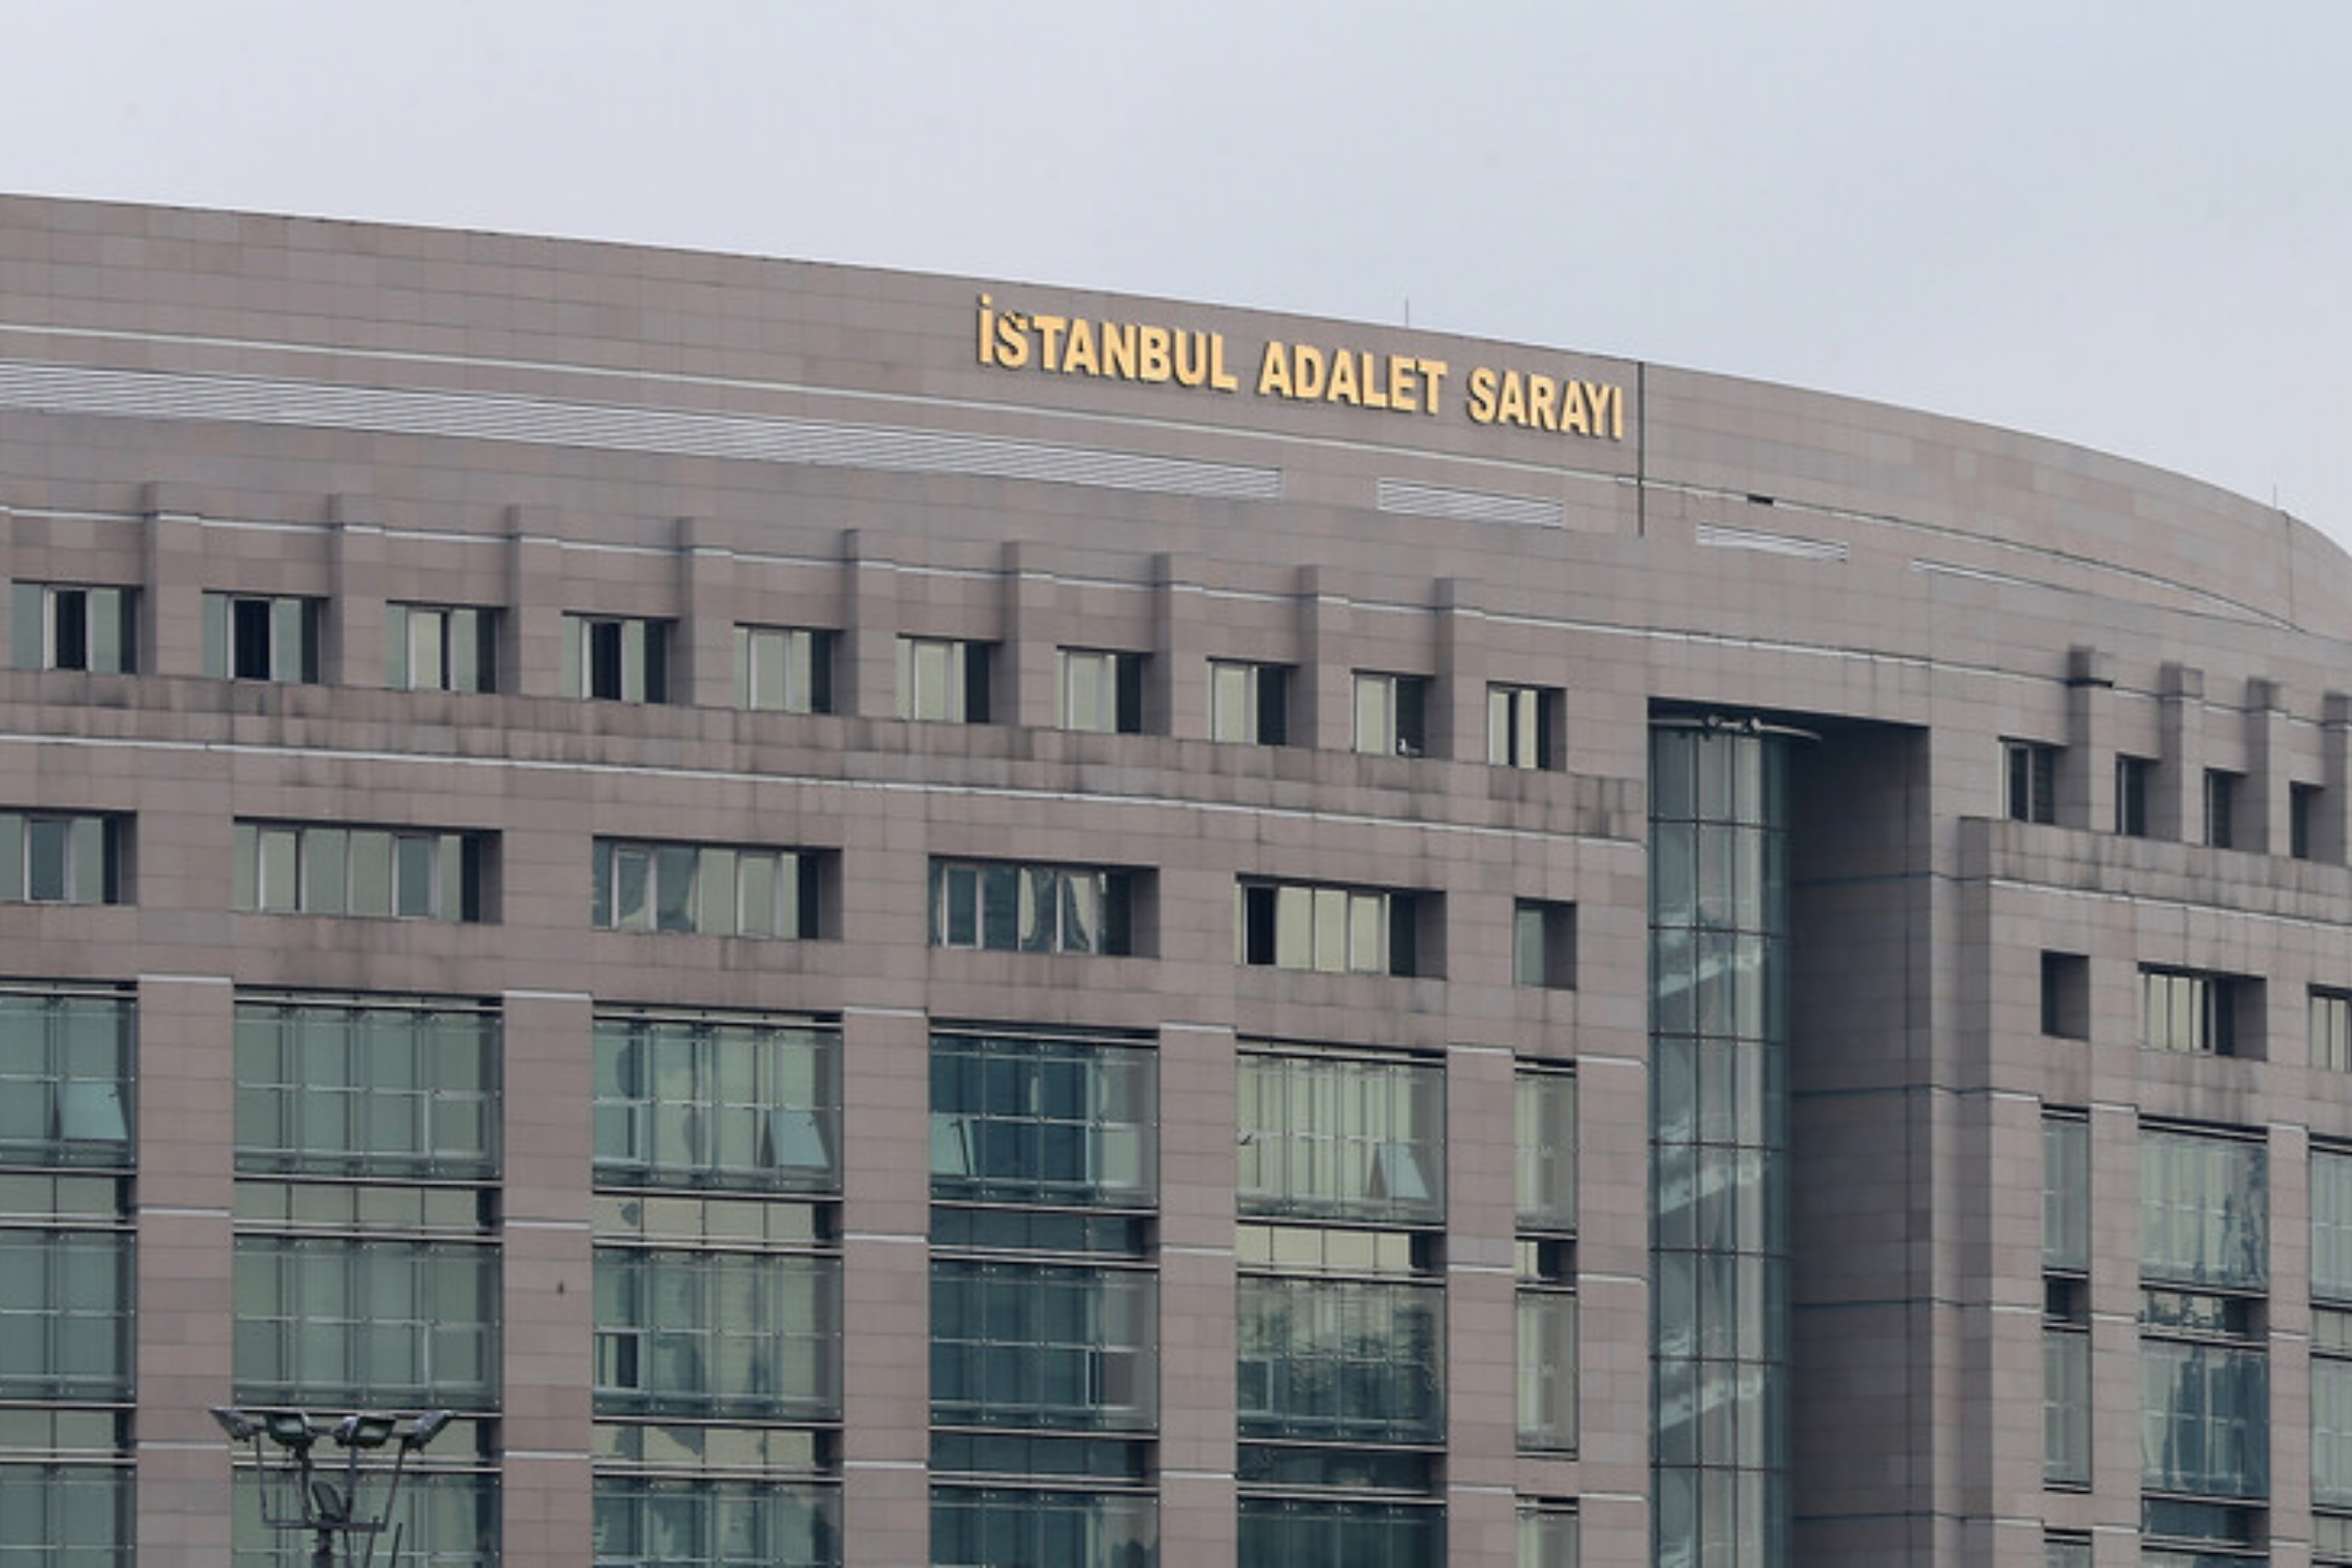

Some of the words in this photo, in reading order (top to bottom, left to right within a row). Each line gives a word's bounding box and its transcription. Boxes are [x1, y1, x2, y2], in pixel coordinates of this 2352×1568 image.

[979, 294, 1238, 390] İSTANBUL
[1259, 341, 1446, 413] ADALET
[1468, 367, 1624, 440] SARAYI
